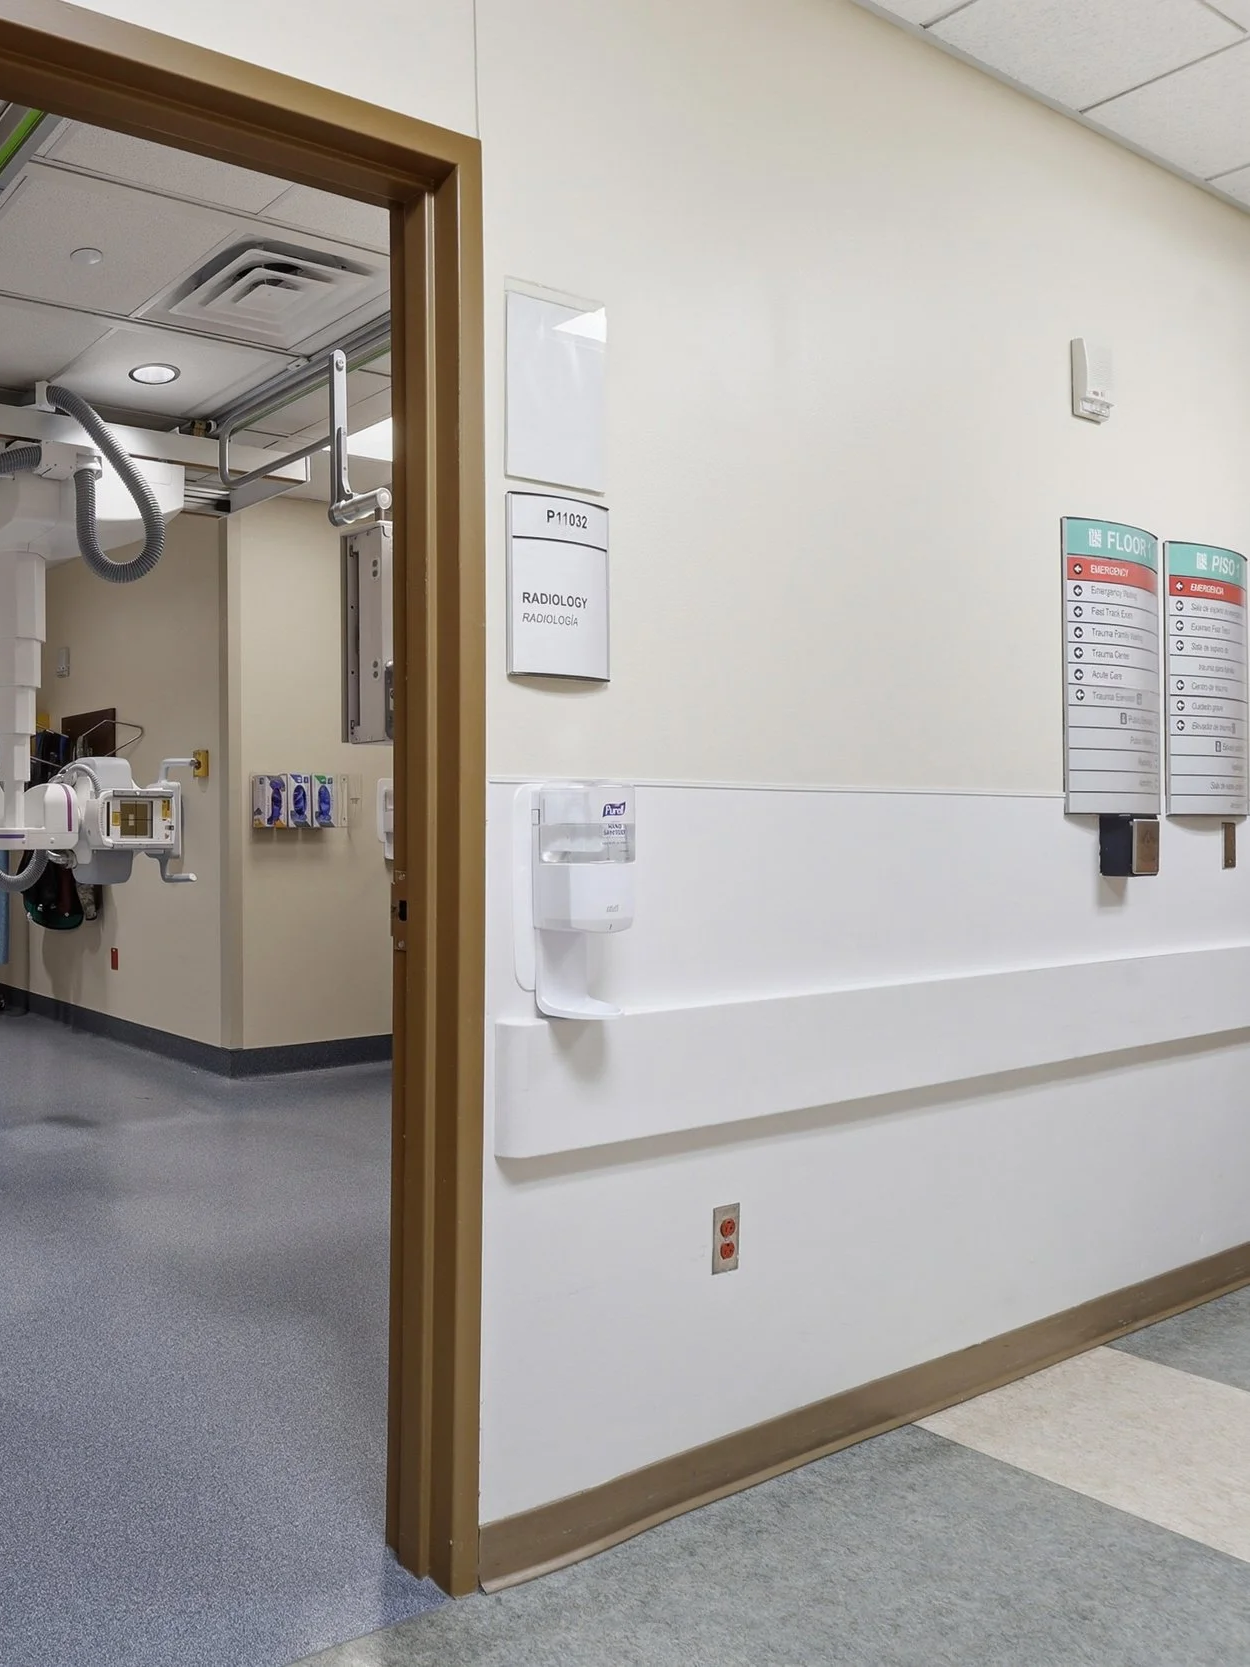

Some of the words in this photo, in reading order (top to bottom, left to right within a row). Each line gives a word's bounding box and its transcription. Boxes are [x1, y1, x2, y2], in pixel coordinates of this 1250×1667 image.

[546, 509, 588, 529] P11032
[1107, 530, 1147, 557] FLOOR
[1211, 555, 1236, 577] PISO
[1091, 585, 1122, 598] Emergency
[522, 592, 588, 609] RADIOLOGY
[1091, 606, 1105, 616] Fast
[1106, 608, 1120, 617] Track
[522, 612, 579, 627] RADIOLOGÍA
[1092, 628, 1113, 638] Trauma
[1092, 649, 1113, 659] Trauma
[1092, 670, 1108, 680] Acute
